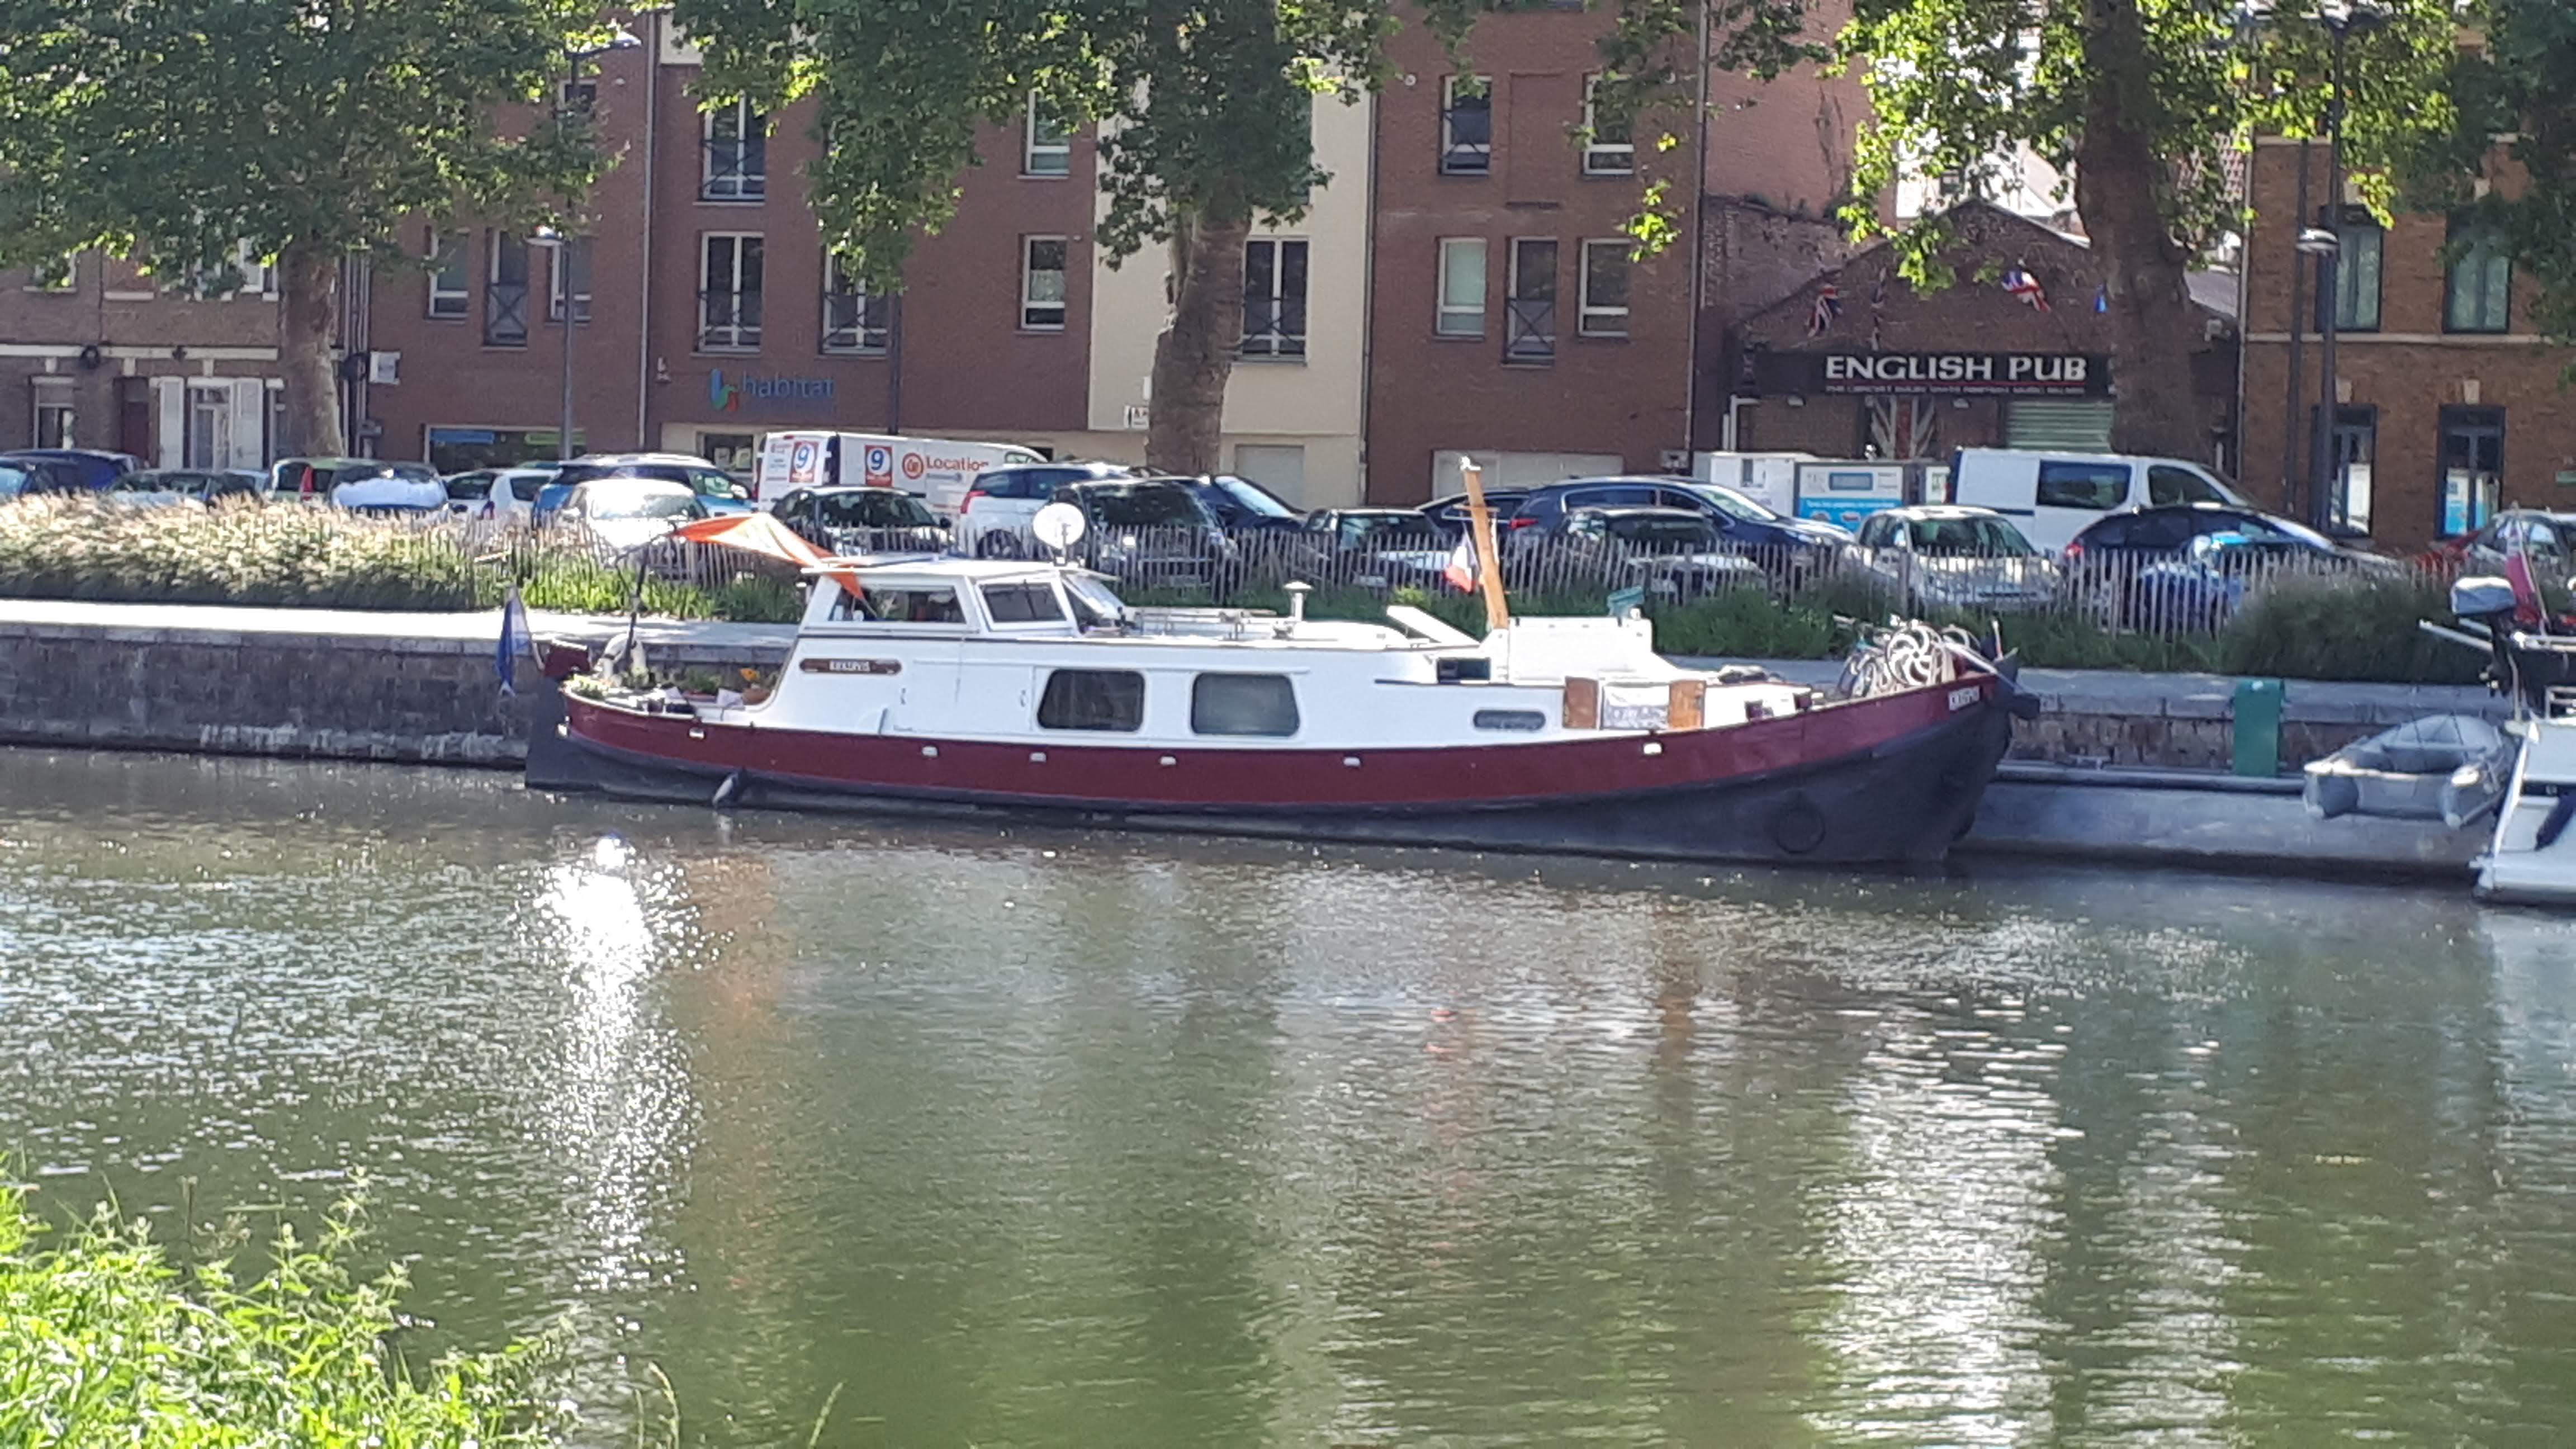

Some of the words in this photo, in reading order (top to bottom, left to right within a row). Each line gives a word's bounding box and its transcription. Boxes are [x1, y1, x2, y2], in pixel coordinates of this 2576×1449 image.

[1825, 356, 1992, 380] ENGLISH
[2008, 356, 2087, 381] PUB
[742, 370, 834, 398] habitat
[795, 445, 810, 469] 9
[870, 449, 885, 471] 9
